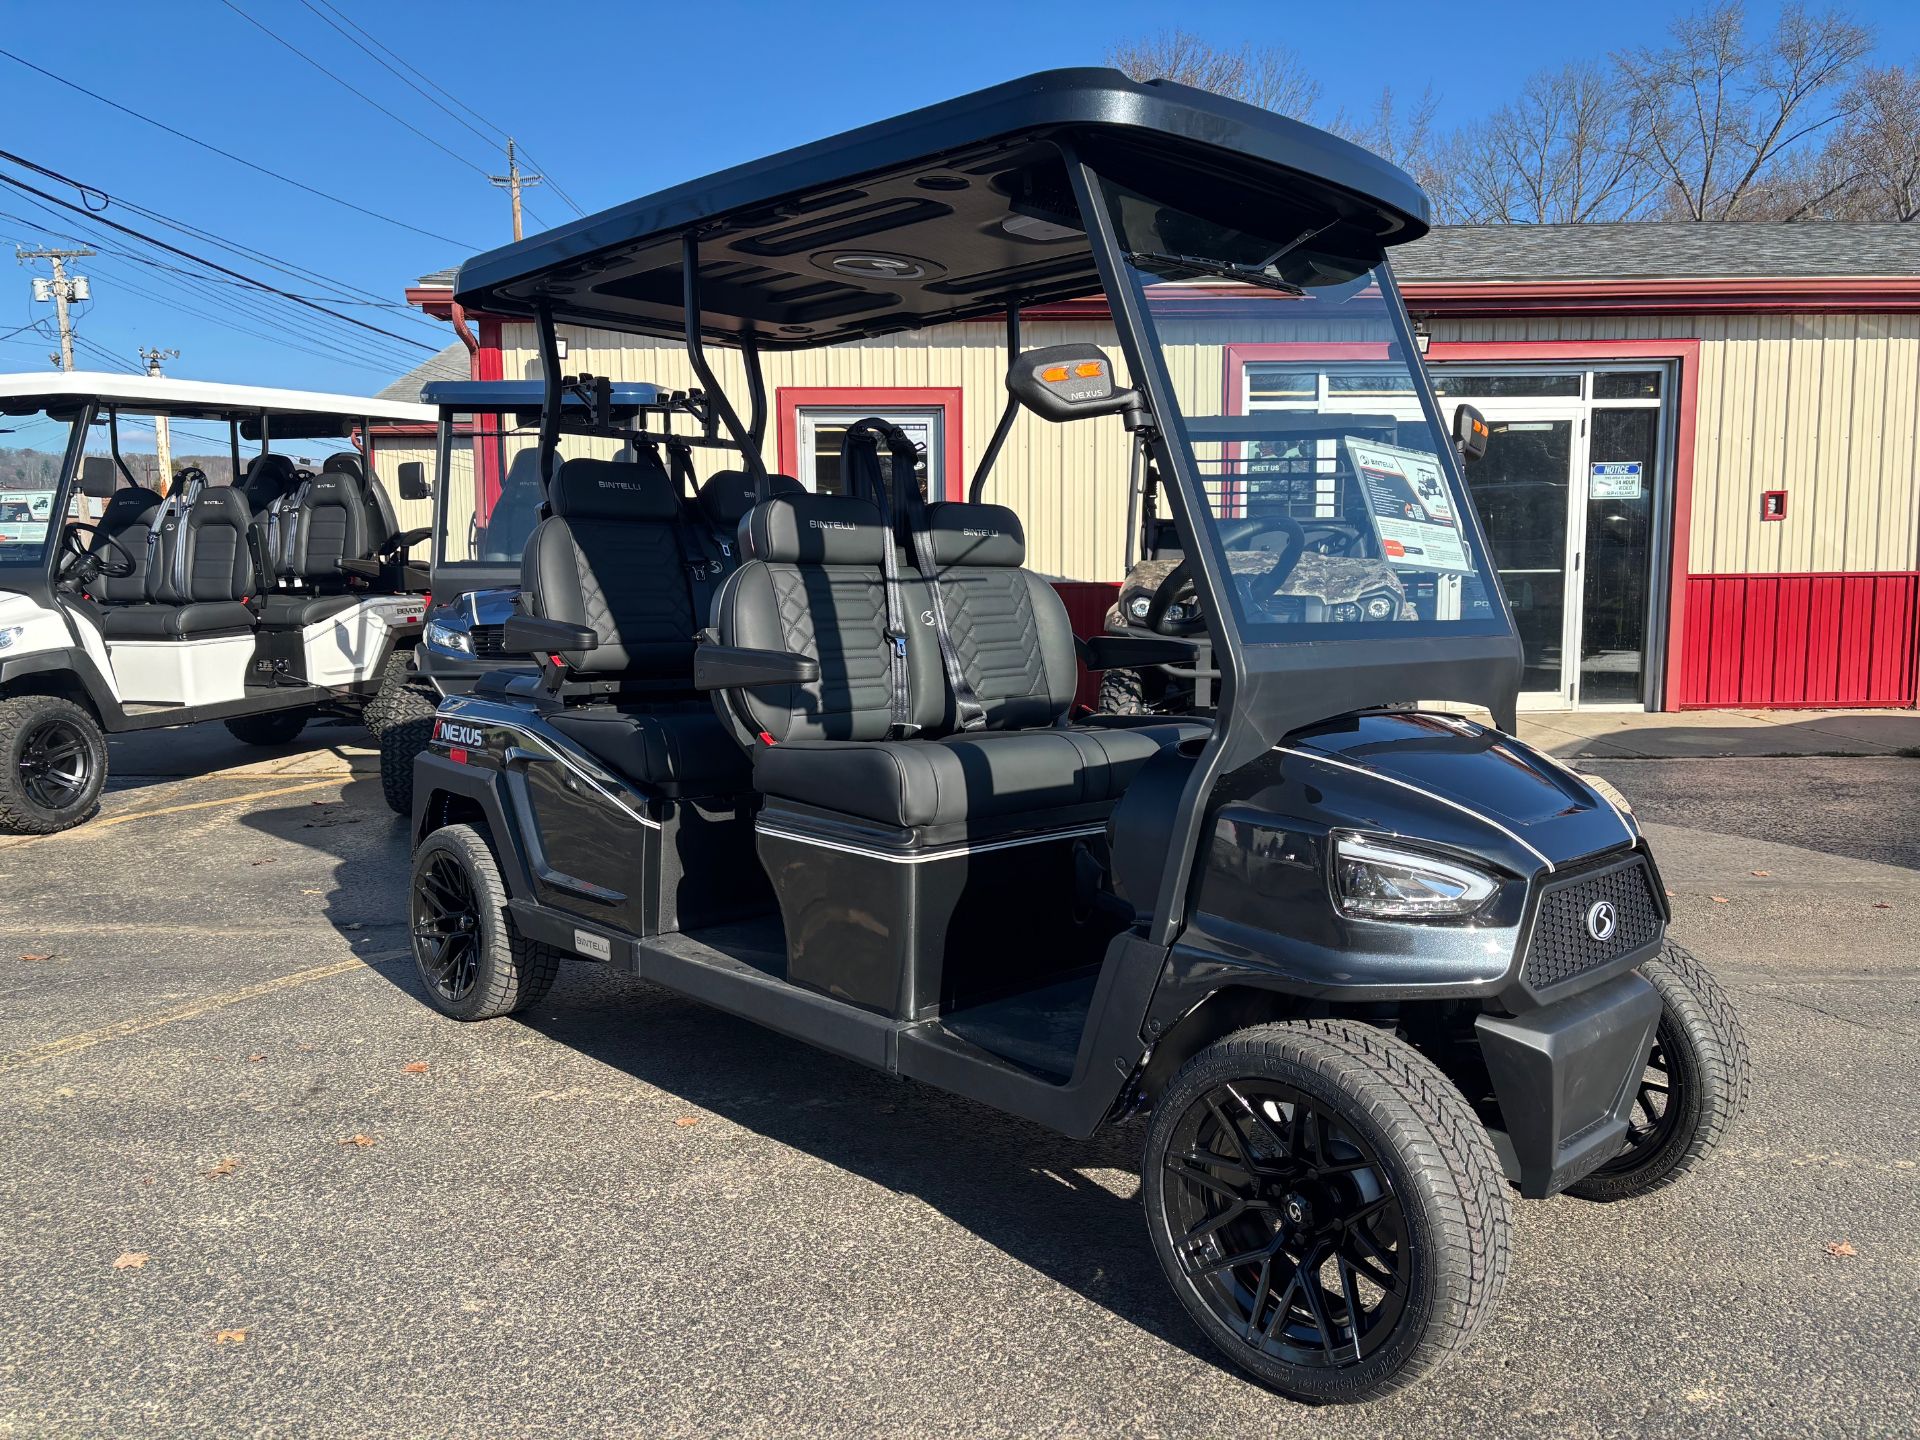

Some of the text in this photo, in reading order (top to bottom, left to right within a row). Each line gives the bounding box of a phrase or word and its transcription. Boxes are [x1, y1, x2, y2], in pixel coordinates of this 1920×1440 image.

[1071, 389, 1103, 400] NEXUS
[1603, 465, 1630, 474] NOTICE
[598, 481, 641, 491] BINTELLI
[809, 519, 856, 531] BINTELLI
[963, 528, 999, 537] BINTELLI
[396, 606, 425, 615] BEYOND
[441, 722, 482, 747] NEXUS
[576, 936, 609, 954] BINTELLI
